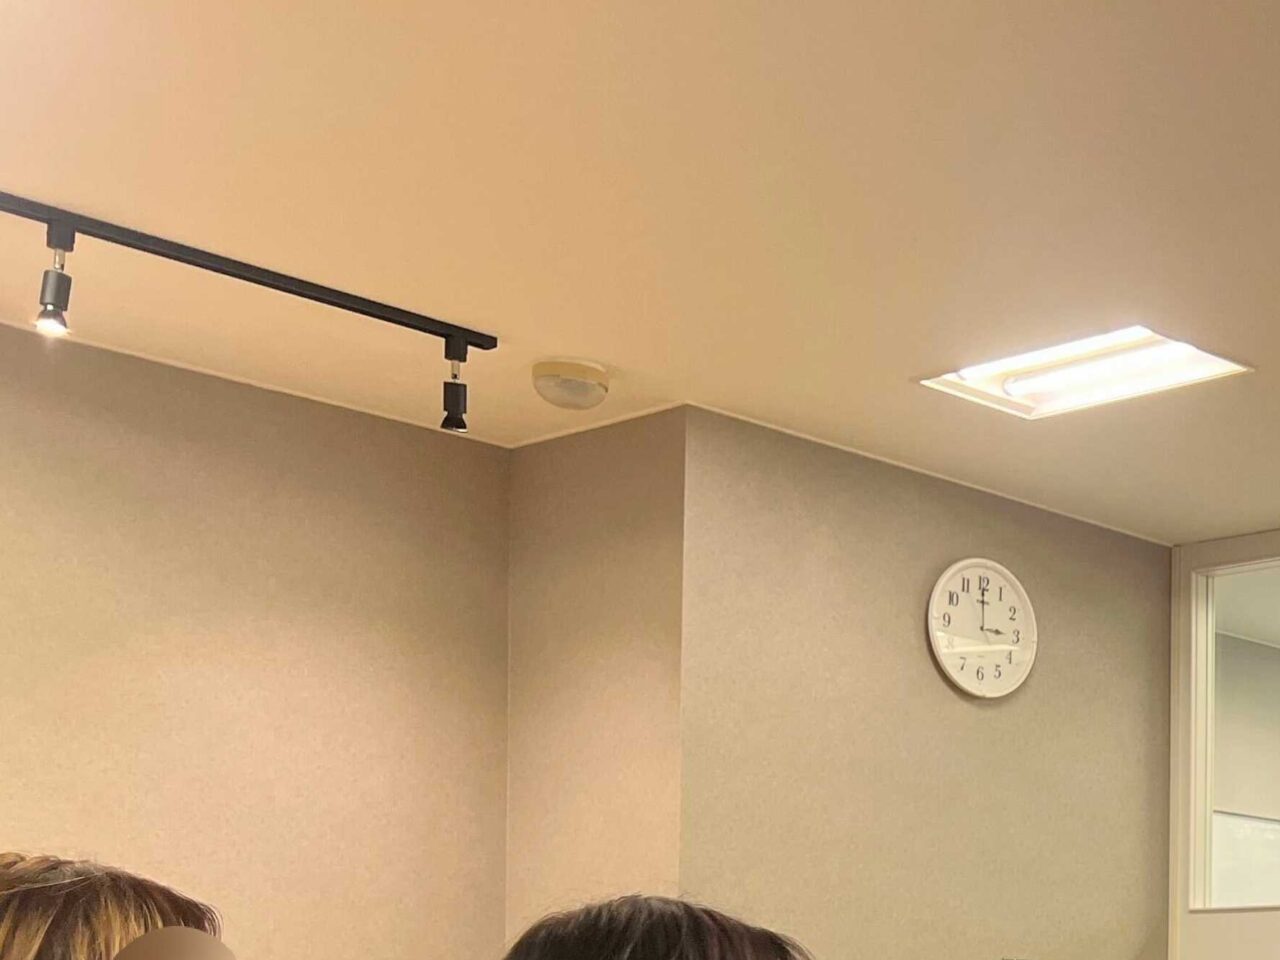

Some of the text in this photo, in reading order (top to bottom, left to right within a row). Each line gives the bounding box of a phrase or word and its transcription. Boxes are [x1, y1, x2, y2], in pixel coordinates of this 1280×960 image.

[961, 577, 970, 593] 11
[978, 576, 990, 592] 12
[948, 590, 959, 607] 10
[998, 586, 1003, 602] 1
[942, 612, 951, 628] 9
[1009, 607, 1017, 621] 2
[1012, 630, 1020, 644] 3
[959, 656, 967, 671] 7
[1005, 650, 1012, 664] 4
[976, 666, 984, 681] 6
[994, 664, 1002, 679] 5
